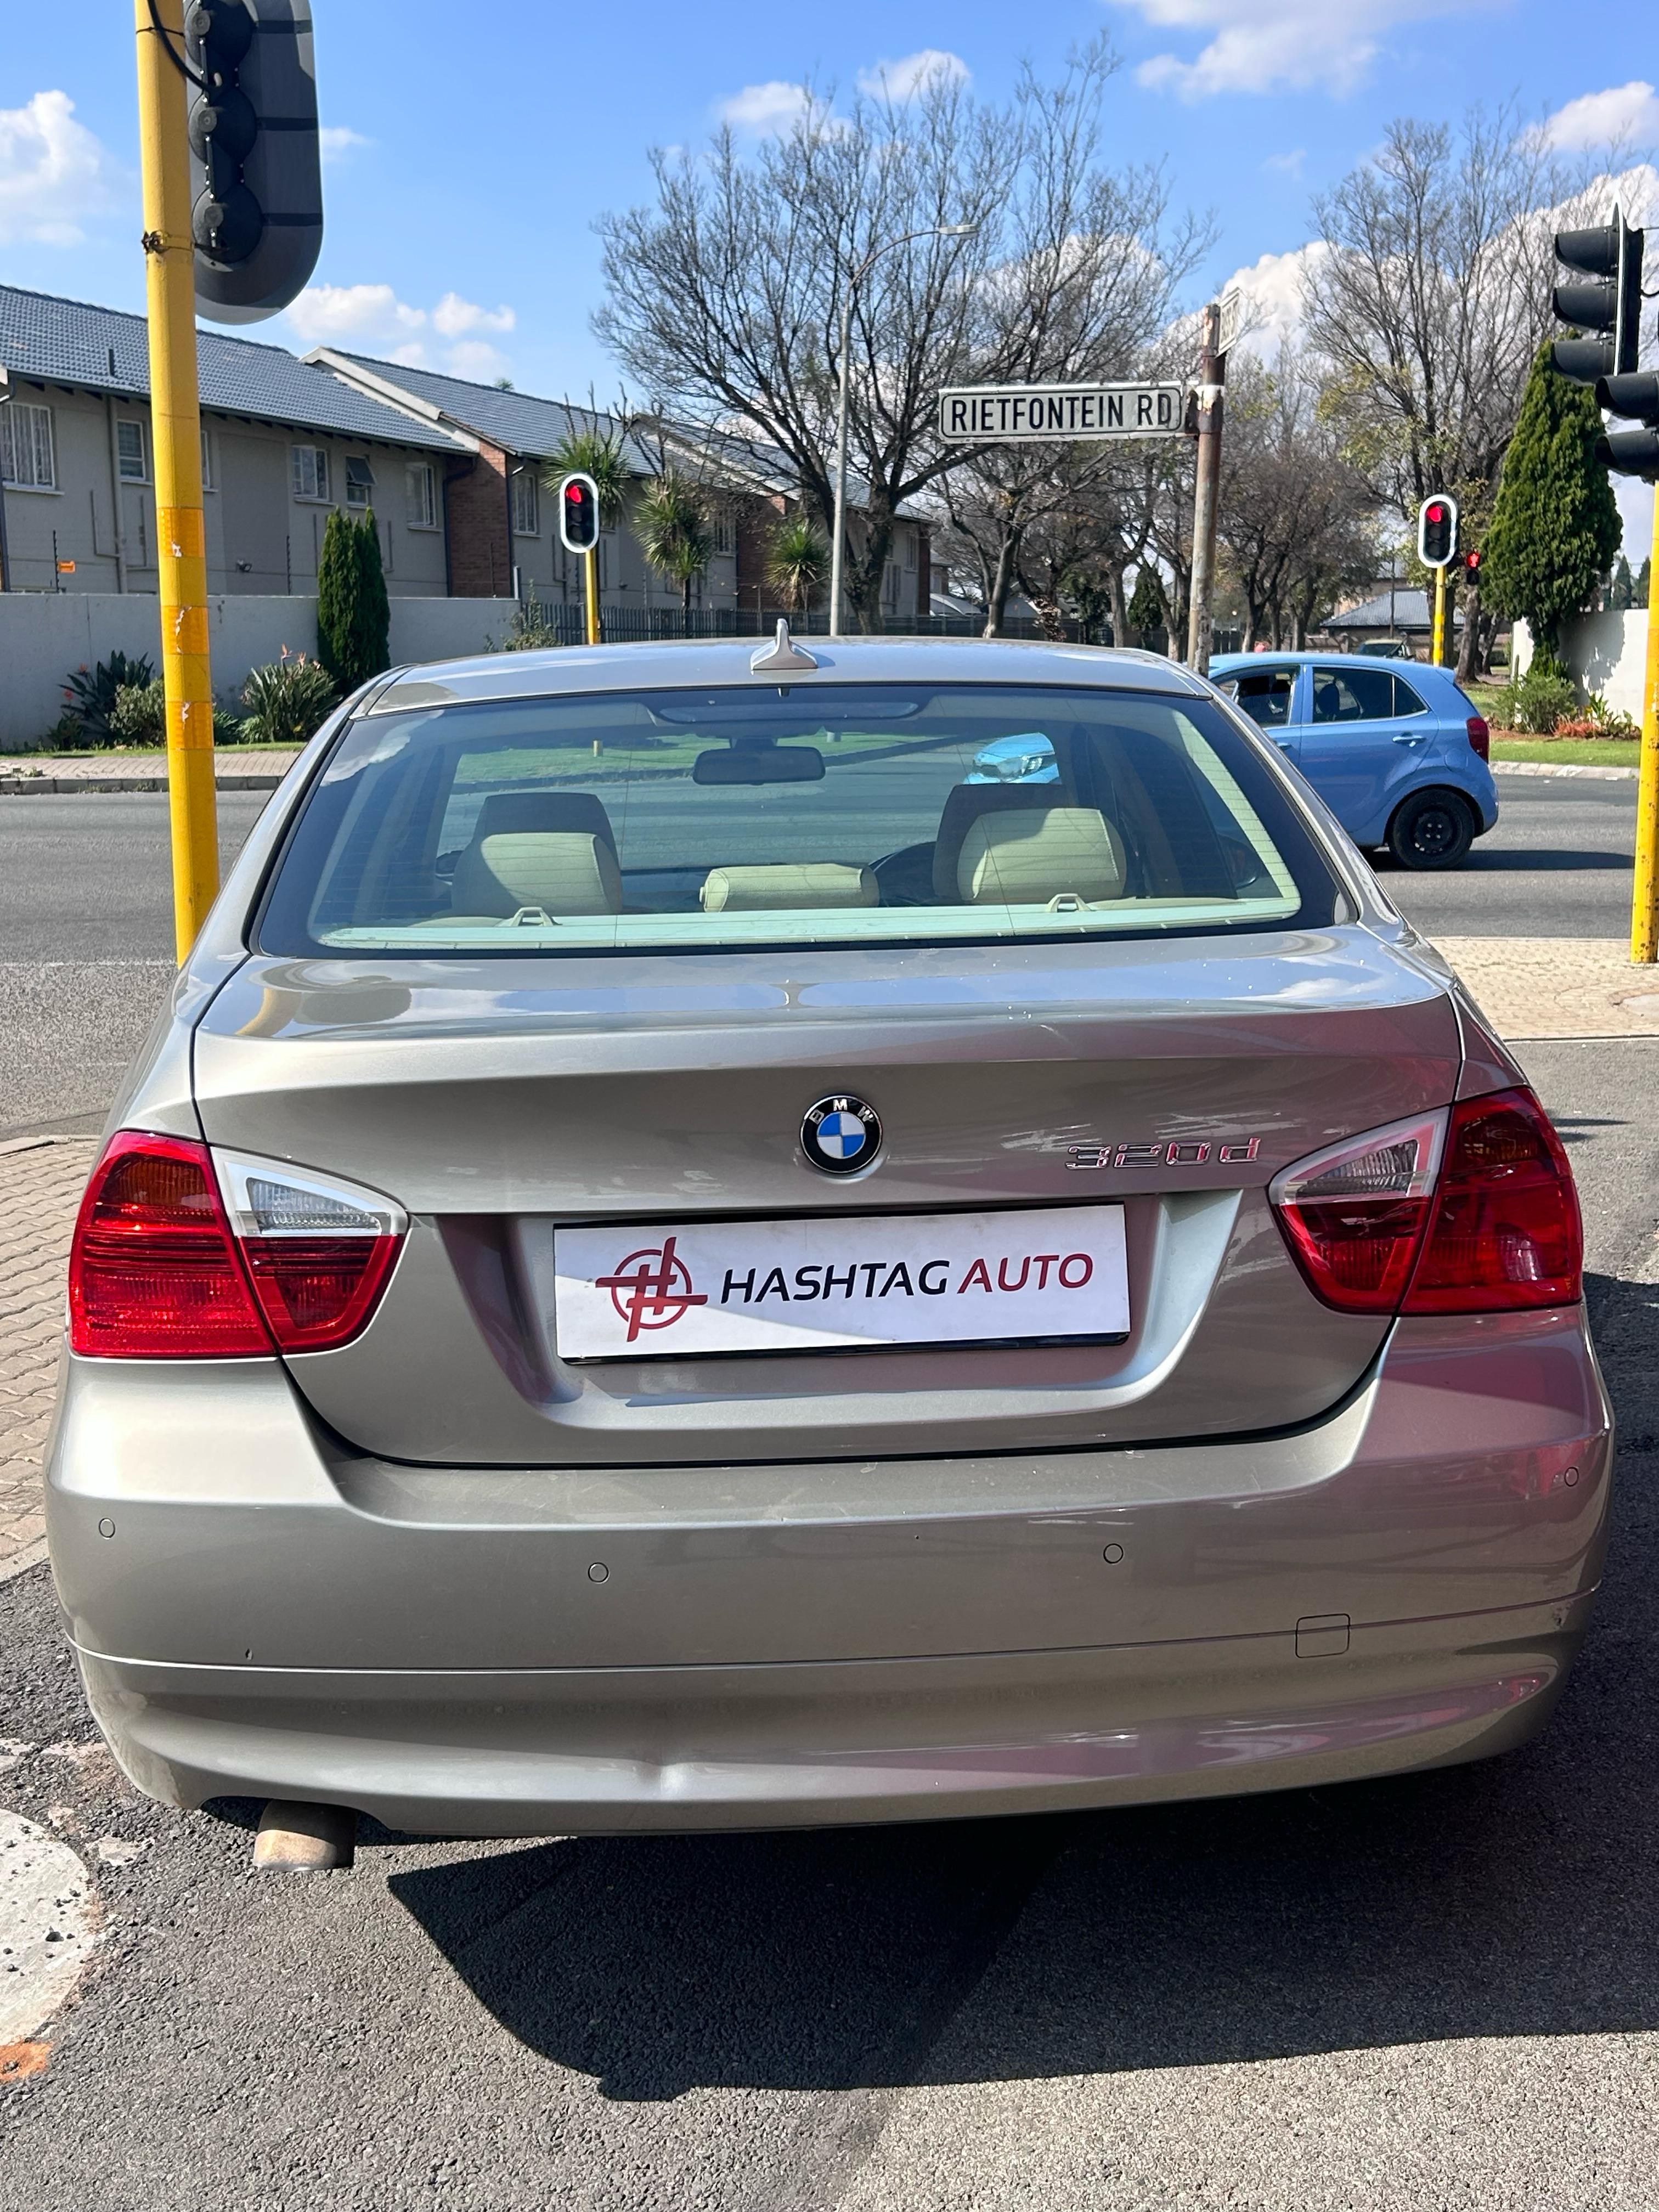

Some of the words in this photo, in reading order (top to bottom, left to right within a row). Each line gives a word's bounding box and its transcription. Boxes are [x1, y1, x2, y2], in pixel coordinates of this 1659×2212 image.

[951, 395, 1123, 431] RIETFONTEIN
[1138, 394, 1172, 426] RD
[809, 1099, 874, 1125] BMW
[1065, 1137, 1261, 1170] 320d
[721, 1260, 950, 1304] HASHTAG
[957, 1254, 1093, 1294] AUTO
